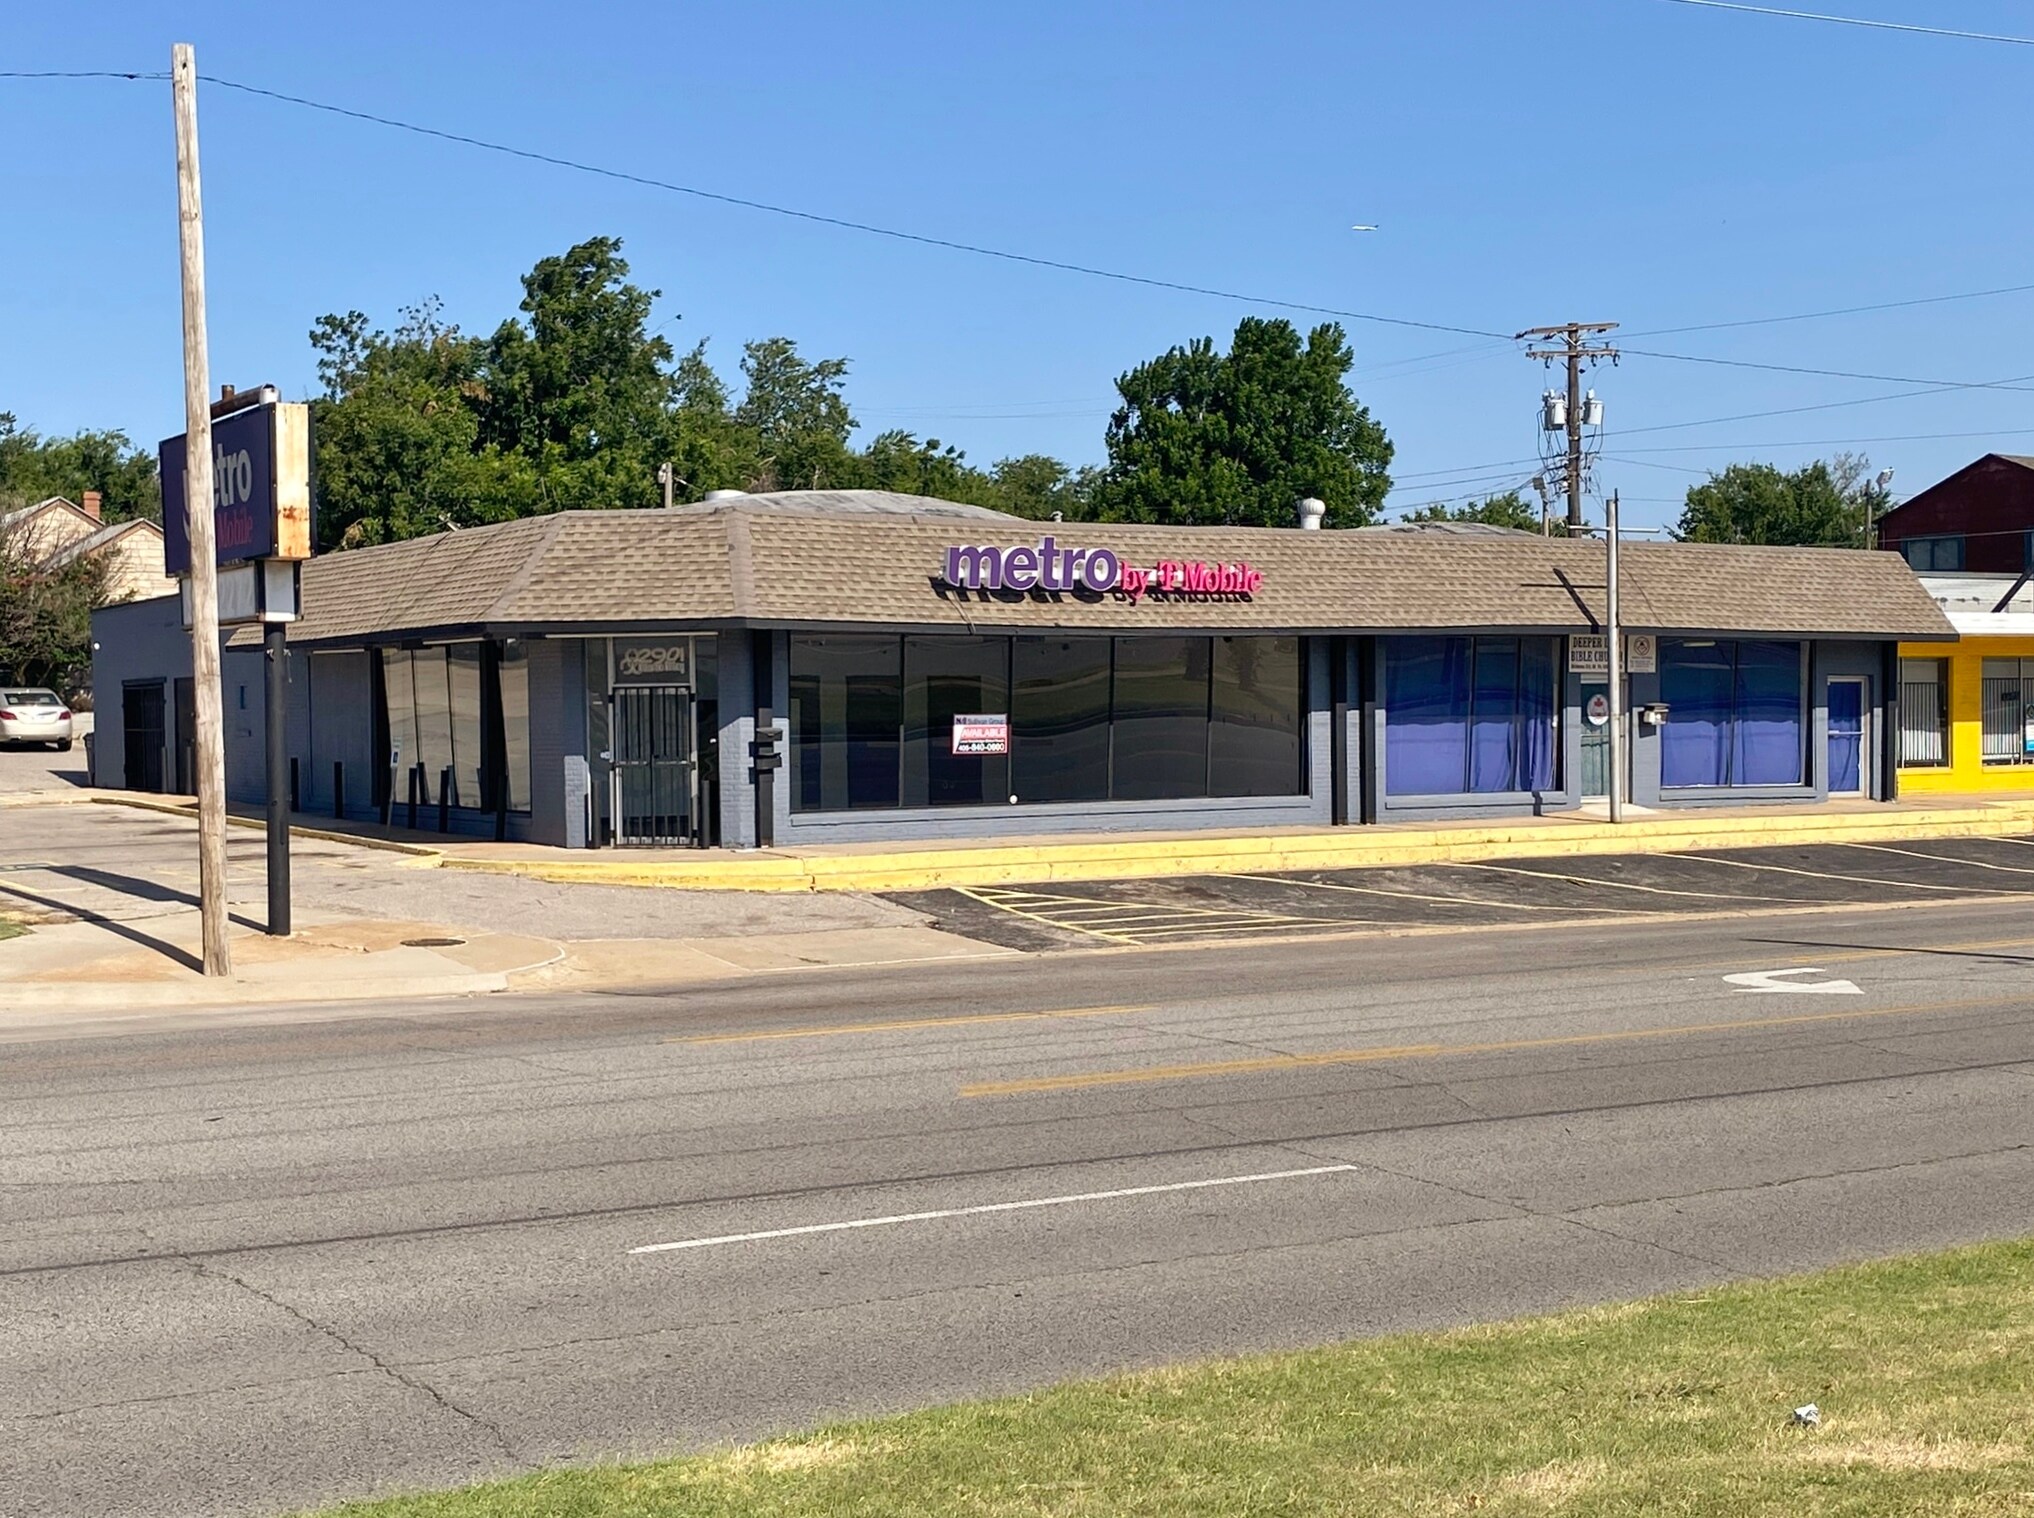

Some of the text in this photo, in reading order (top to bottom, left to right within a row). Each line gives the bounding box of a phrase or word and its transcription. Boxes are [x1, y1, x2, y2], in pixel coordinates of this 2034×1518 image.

[945, 536, 1118, 592] metro
[1121, 561, 1151, 598] by
[1573, 637, 1602, 648] DEEPER
[1571, 651, 1592, 662] BIBLE
[961, 728, 1006, 738] AVAILABLE
